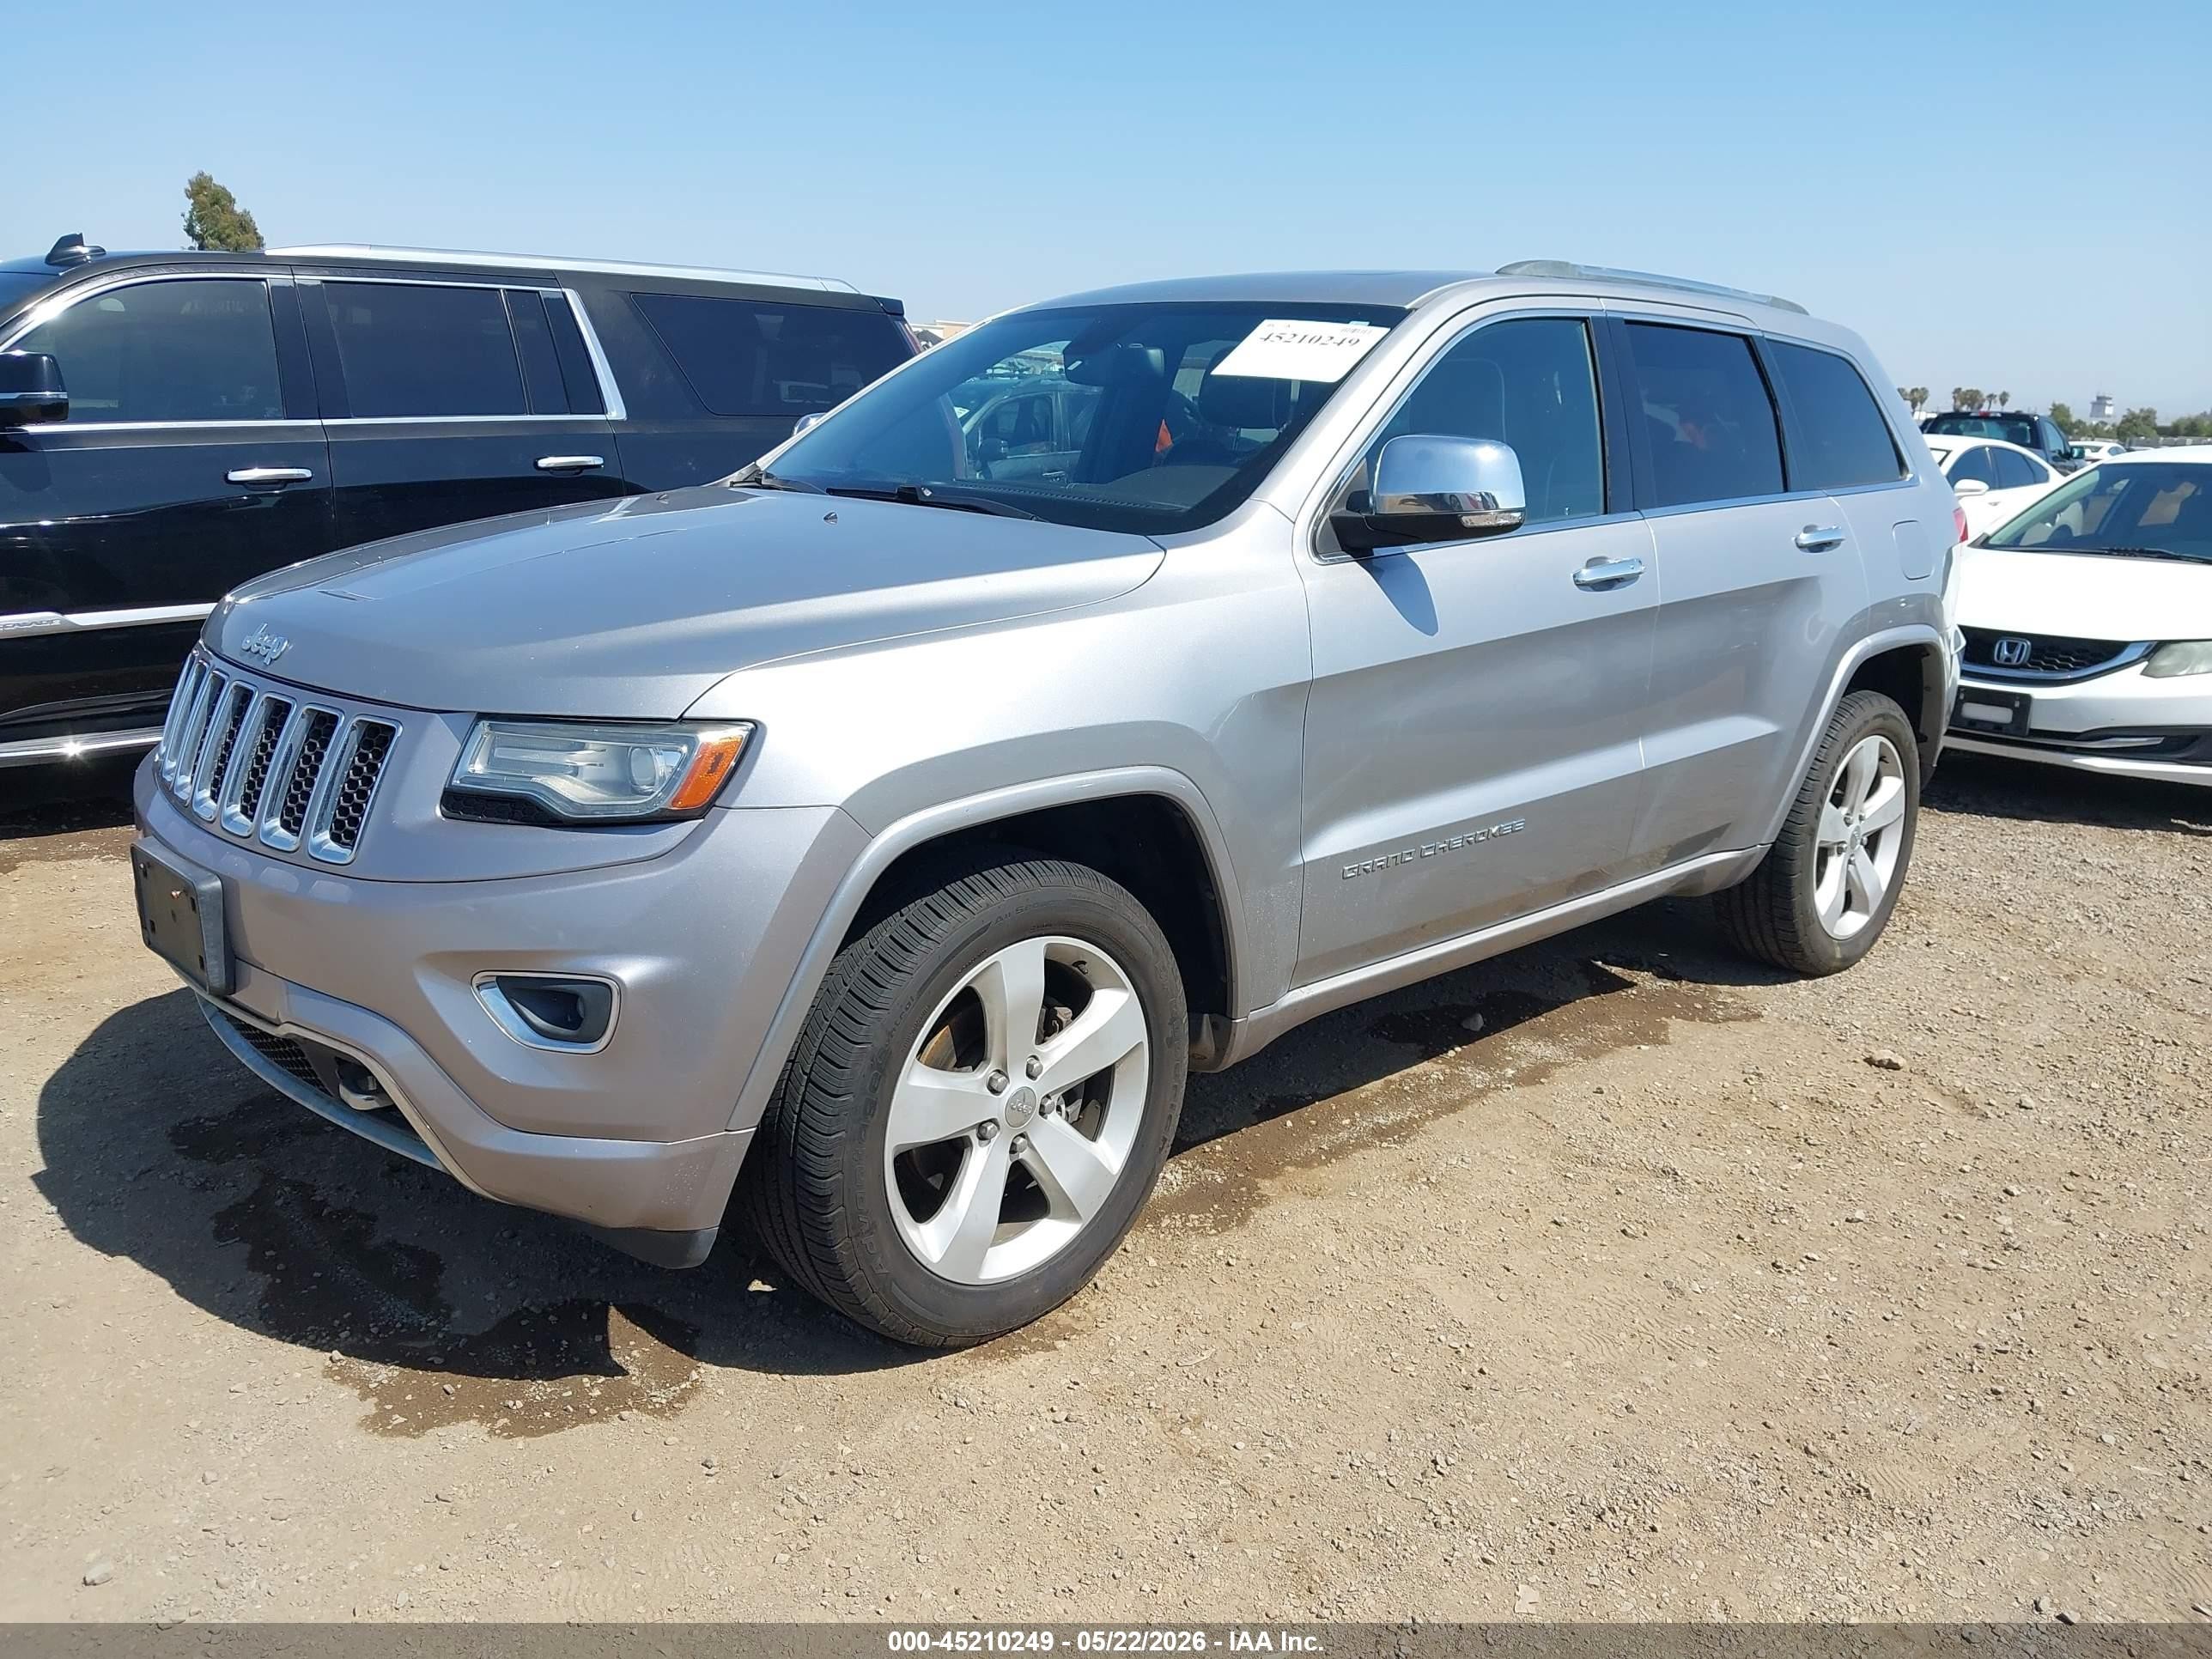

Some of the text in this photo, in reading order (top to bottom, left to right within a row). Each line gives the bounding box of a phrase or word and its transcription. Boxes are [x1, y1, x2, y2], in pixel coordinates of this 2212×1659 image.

[1260, 331, 1361, 346] 45210249
[241, 623, 289, 665] Jeep
[1342, 818, 1526, 880] GRAND CHEROKEE
